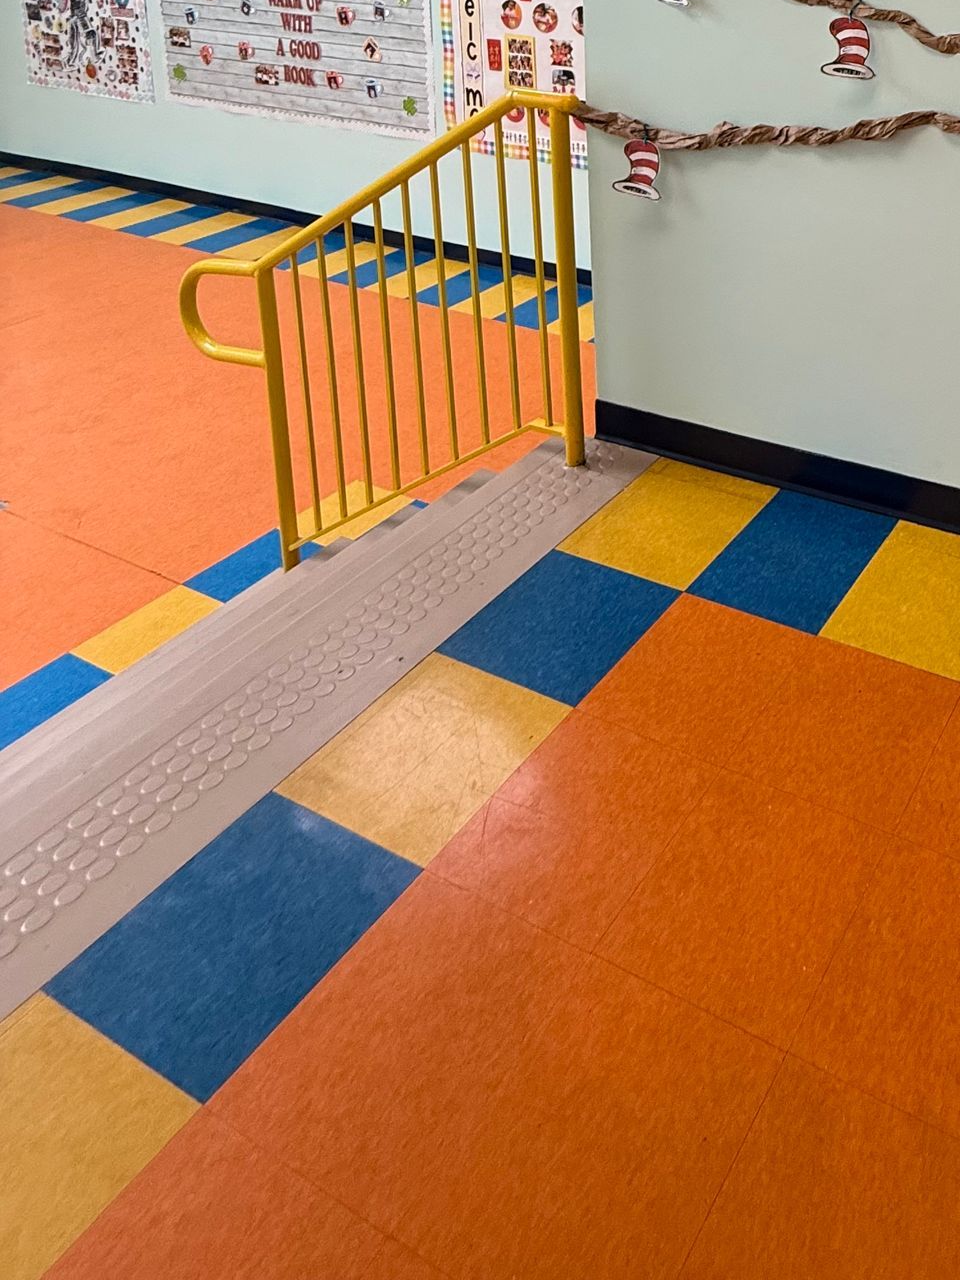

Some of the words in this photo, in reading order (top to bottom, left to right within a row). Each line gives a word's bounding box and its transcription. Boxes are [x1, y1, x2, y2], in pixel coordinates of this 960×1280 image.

[280, 12, 313, 33] WITH
[276, 38, 285, 56] A
[289, 39, 320, 60] GOOD
[284, 65, 316, 86] BOOK
